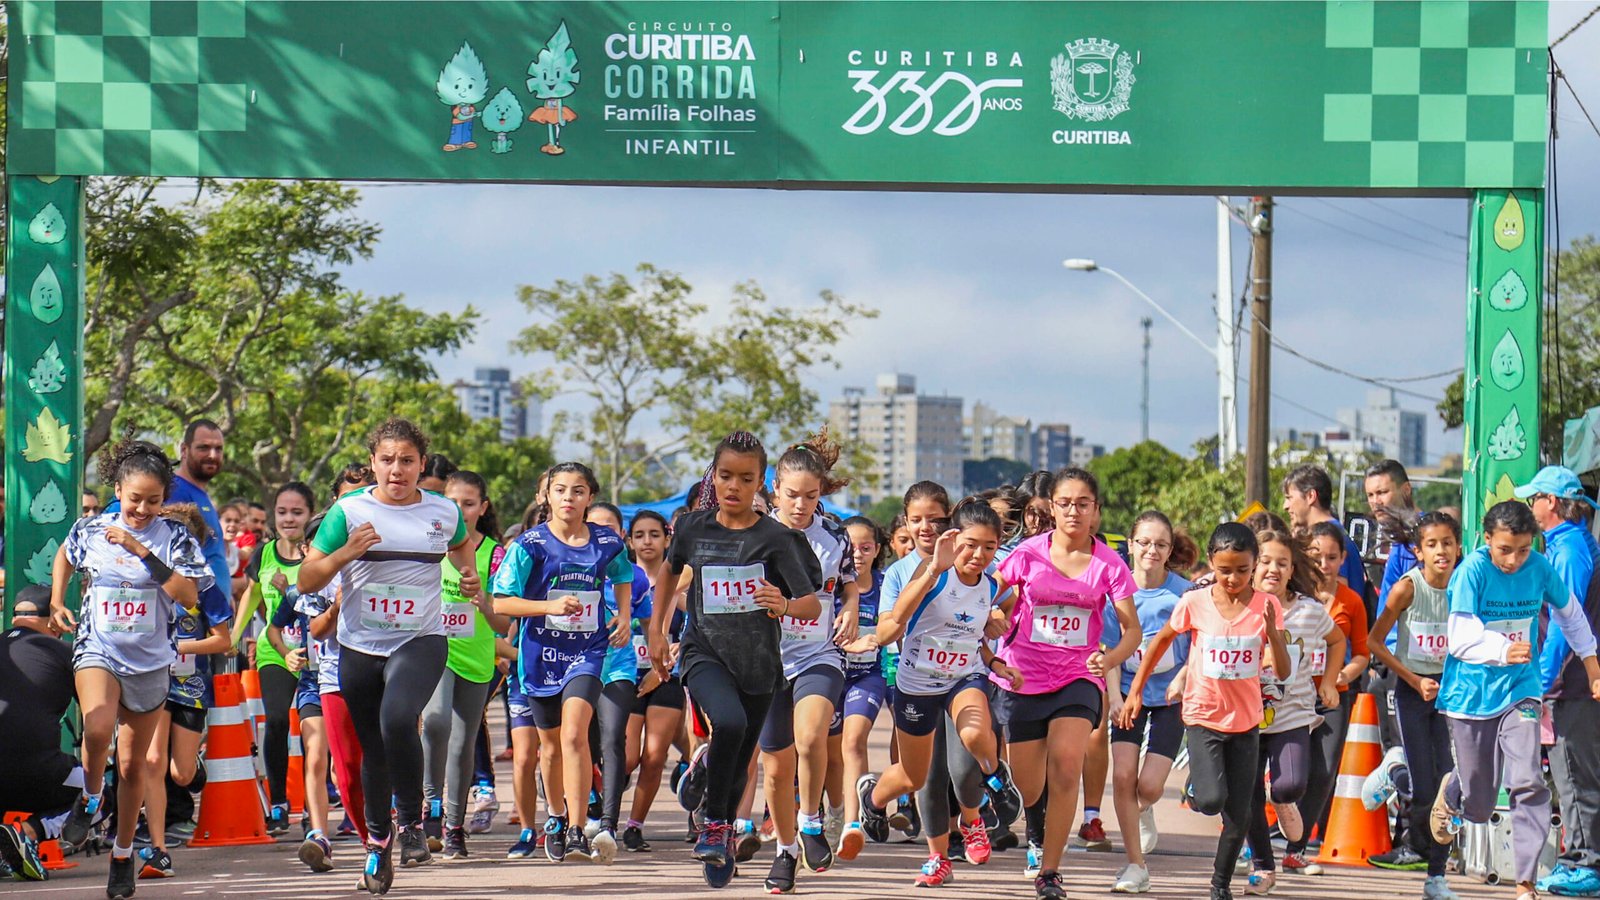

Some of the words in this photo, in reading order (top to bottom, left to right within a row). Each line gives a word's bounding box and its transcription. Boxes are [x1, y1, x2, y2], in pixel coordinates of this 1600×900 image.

[628, 21, 732, 32] CIRCUITO
[604, 33, 756, 61] CURITIBA
[847, 49, 1023, 67] CURITIBA
[604, 64, 756, 99] CORRIDA
[982, 97, 1023, 111] ANOS
[604, 104, 681, 122] Família
[687, 105, 756, 122] Folhas
[1052, 130, 1132, 144] CURITIBA
[626, 139, 735, 155] INFANTIL
[560, 572, 594, 583] TRIATHLON
[711, 579, 757, 596] 1115
[101, 601, 147, 616] 1104
[369, 597, 415, 614] 1112
[1040, 615, 1081, 631] 1120
[536, 627, 596, 640] VOLV
[1416, 634, 1448, 648] 110
[926, 648, 968, 666] 1075
[1209, 648, 1252, 664] 1078
